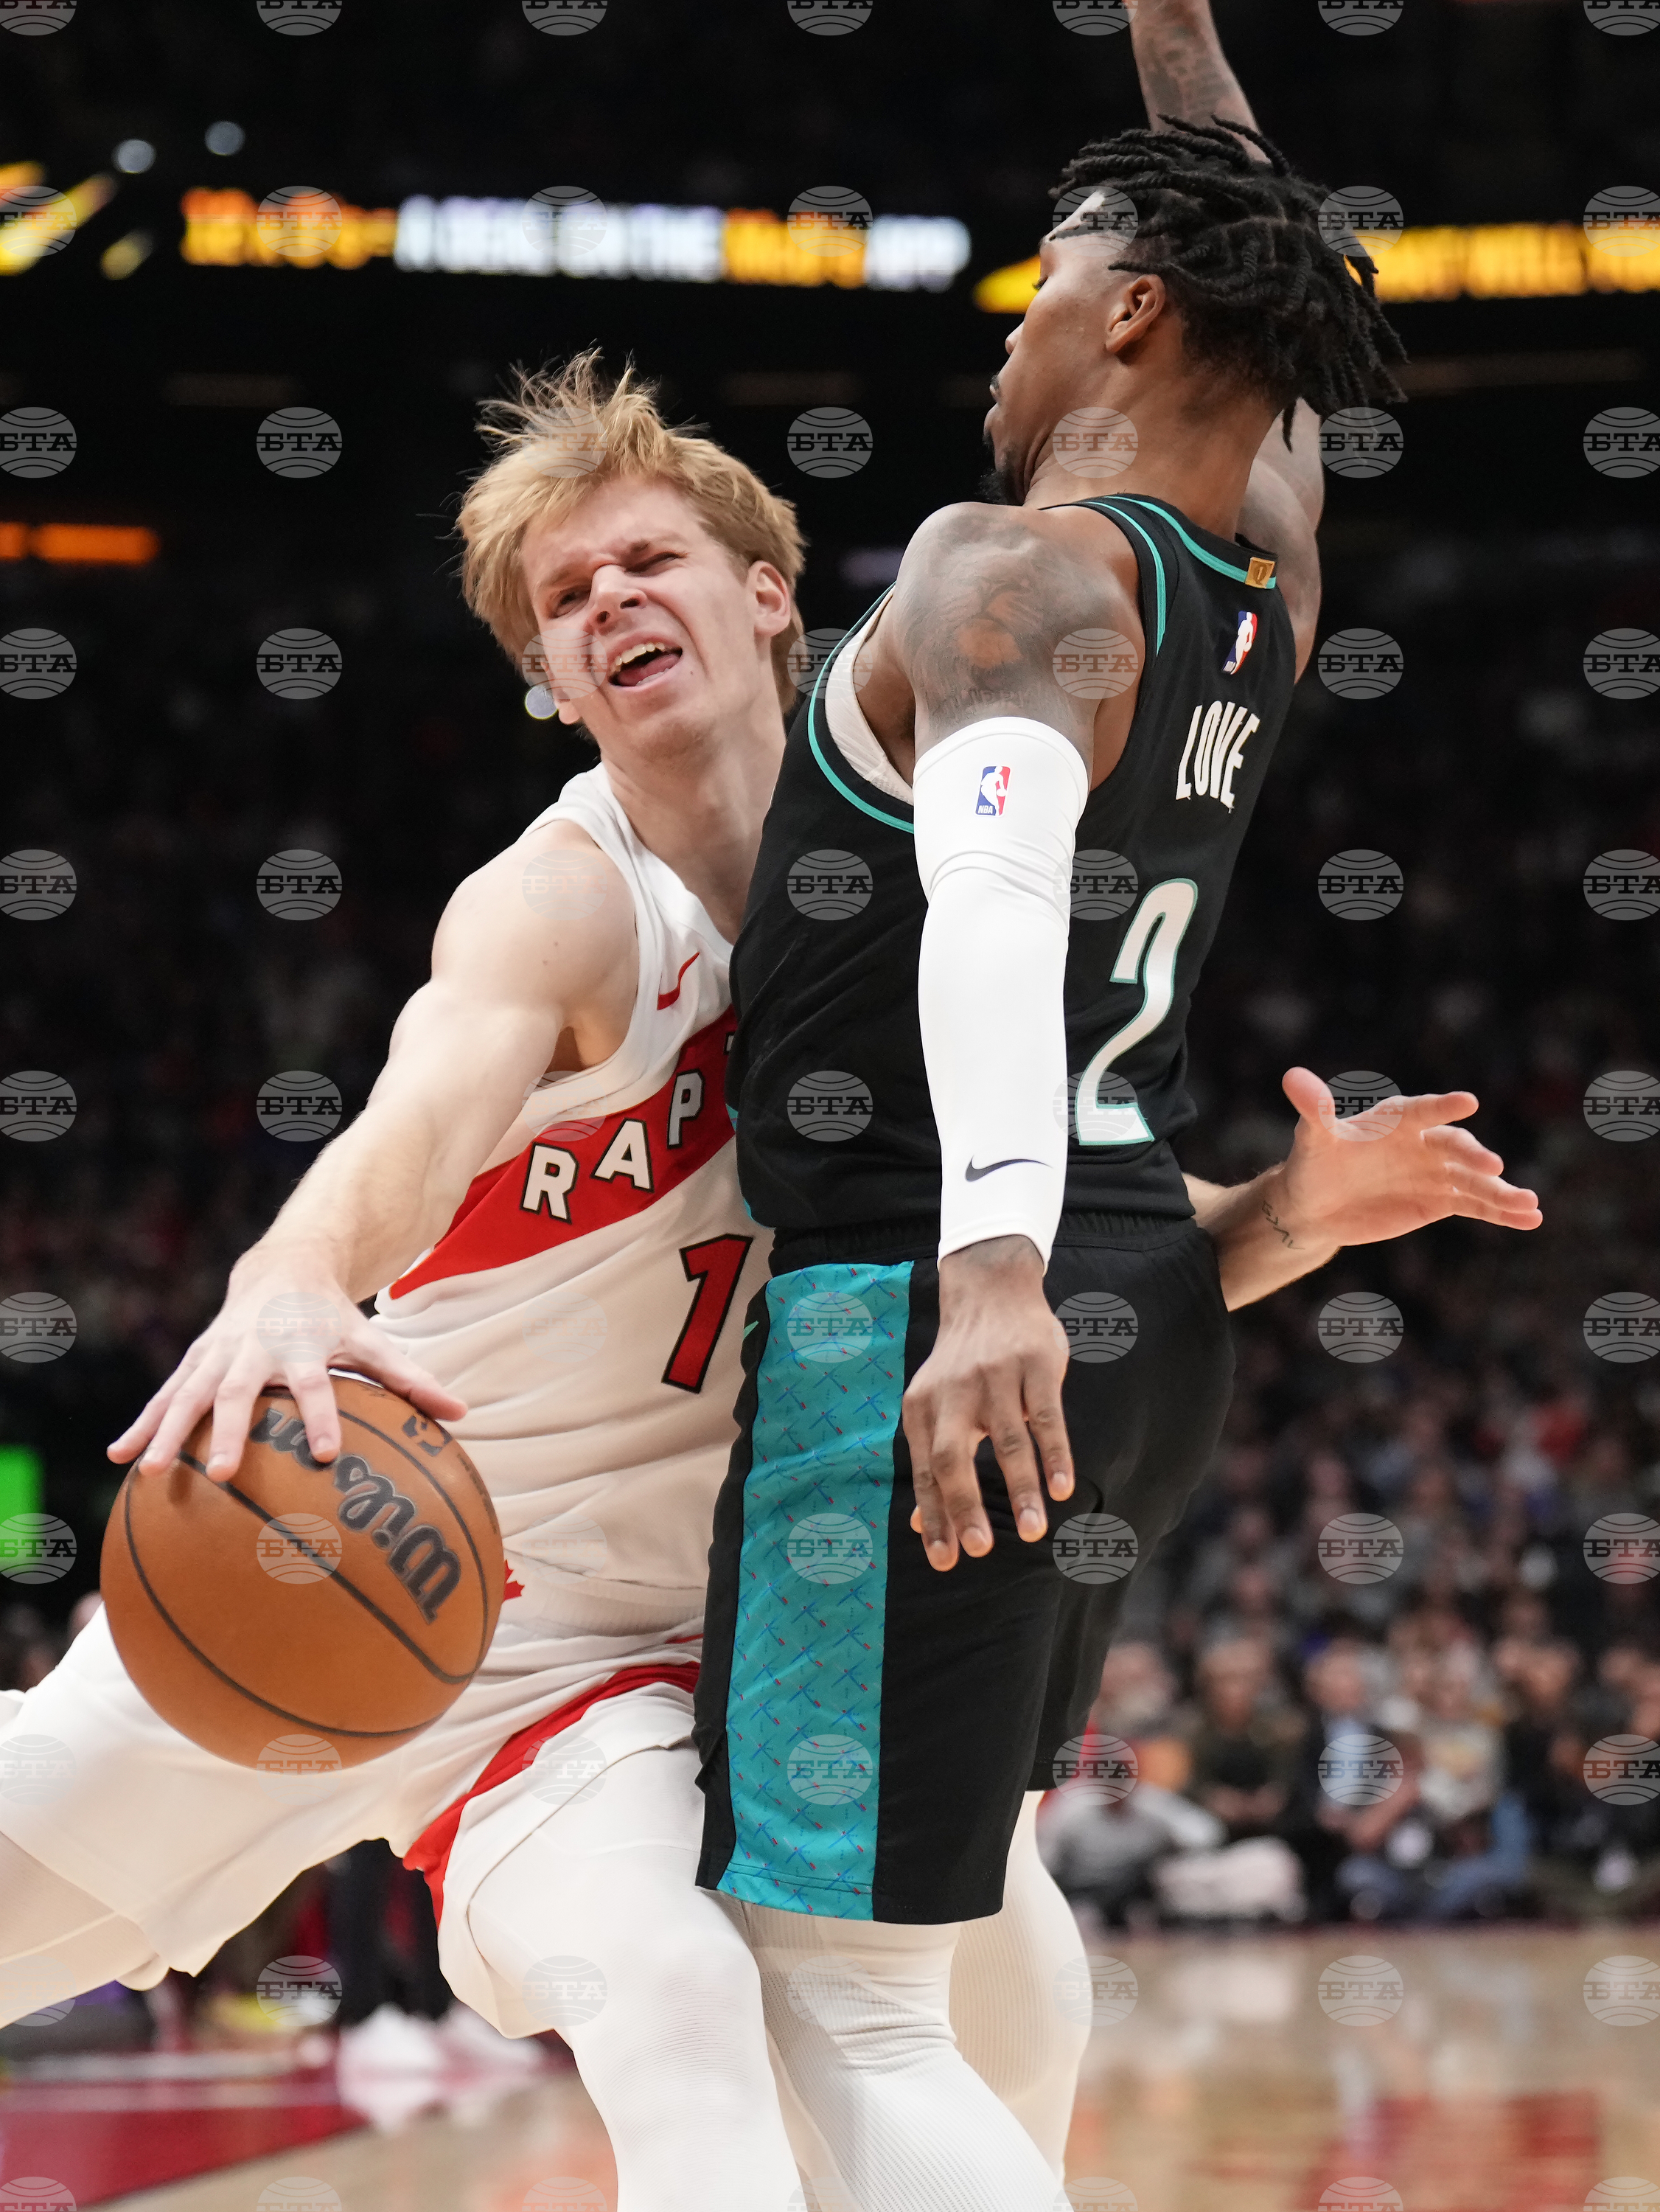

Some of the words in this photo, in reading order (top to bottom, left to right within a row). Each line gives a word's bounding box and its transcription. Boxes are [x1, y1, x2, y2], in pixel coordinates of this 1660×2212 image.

[977, 804, 994, 814] NBA
[1176, 700, 1260, 810] LOVE
[1075, 877, 1199, 1146] 2
[519, 1031, 735, 1225] RAP
[660, 1234, 753, 1394] 1
